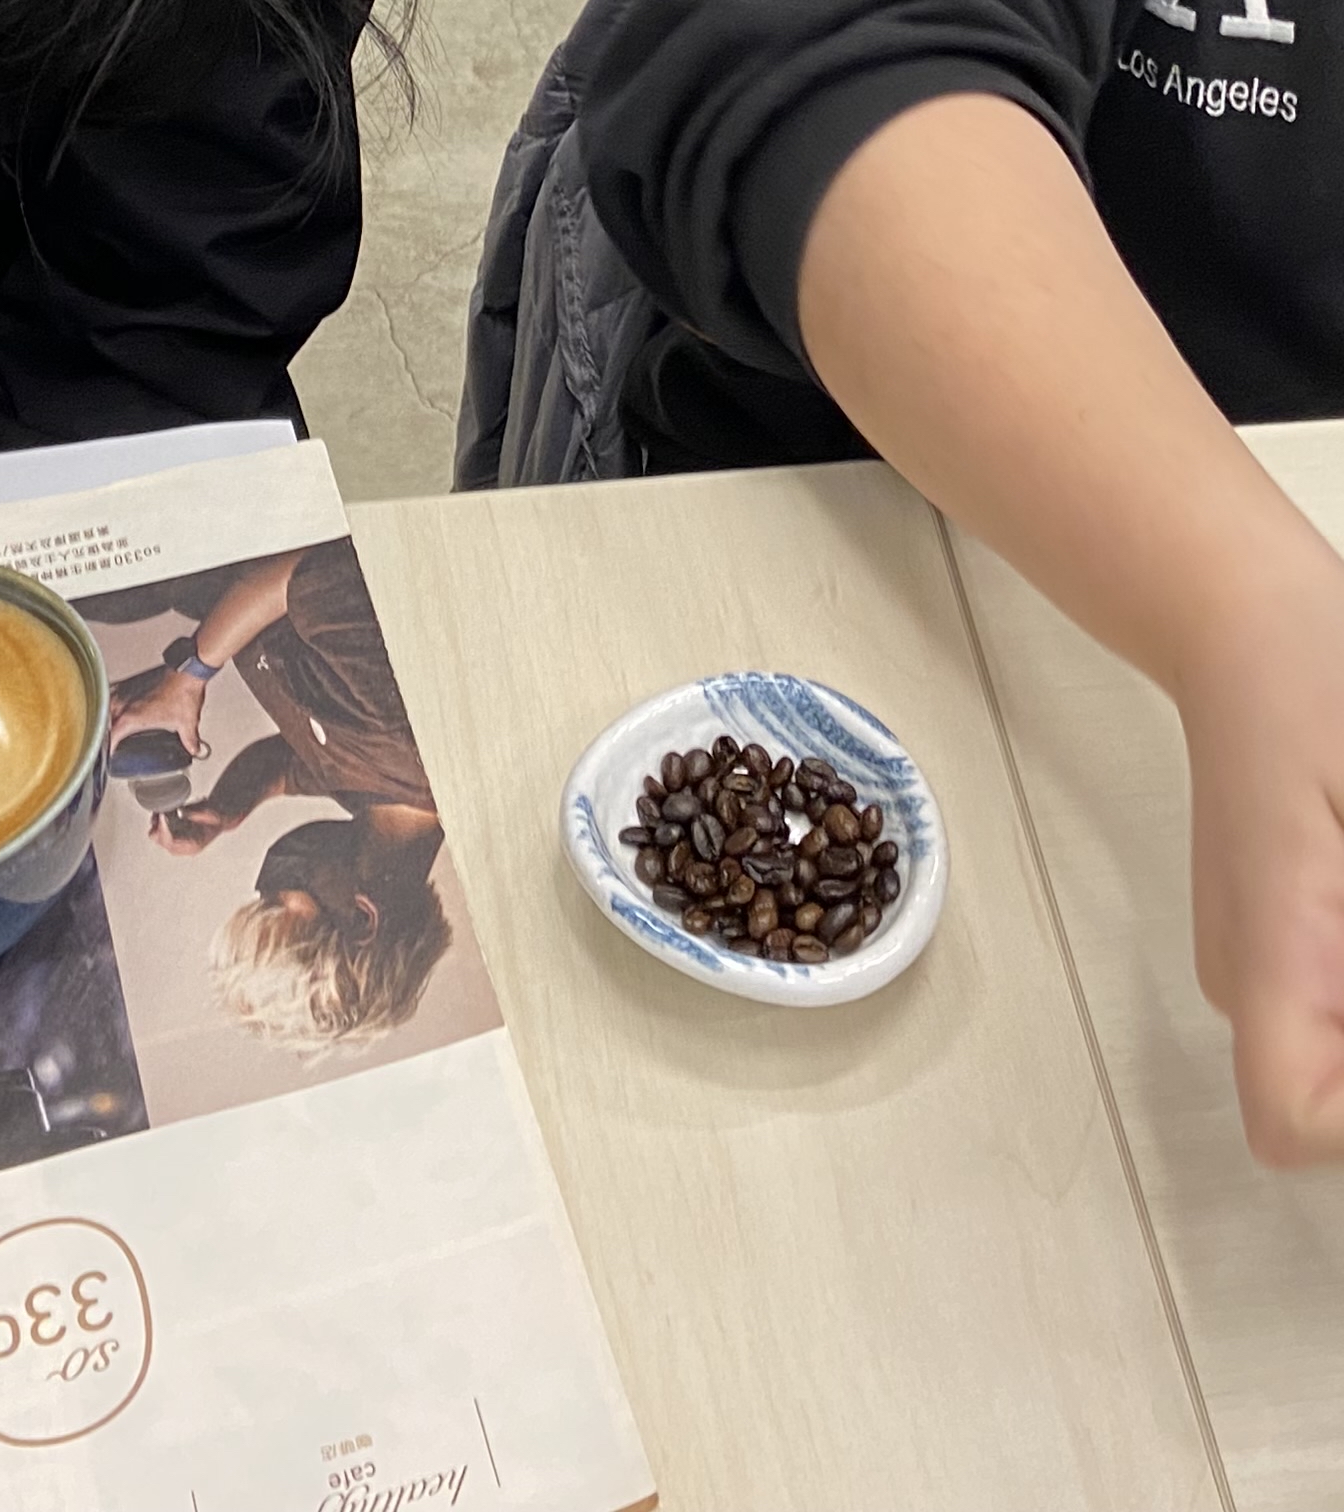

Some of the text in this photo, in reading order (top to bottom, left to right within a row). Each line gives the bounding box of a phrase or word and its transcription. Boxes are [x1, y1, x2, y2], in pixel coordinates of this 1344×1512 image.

[1163, 64, 1298, 123] Angeles
[45, 1339, 119, 1382] so
[327, 1462, 376, 1490] cafe
